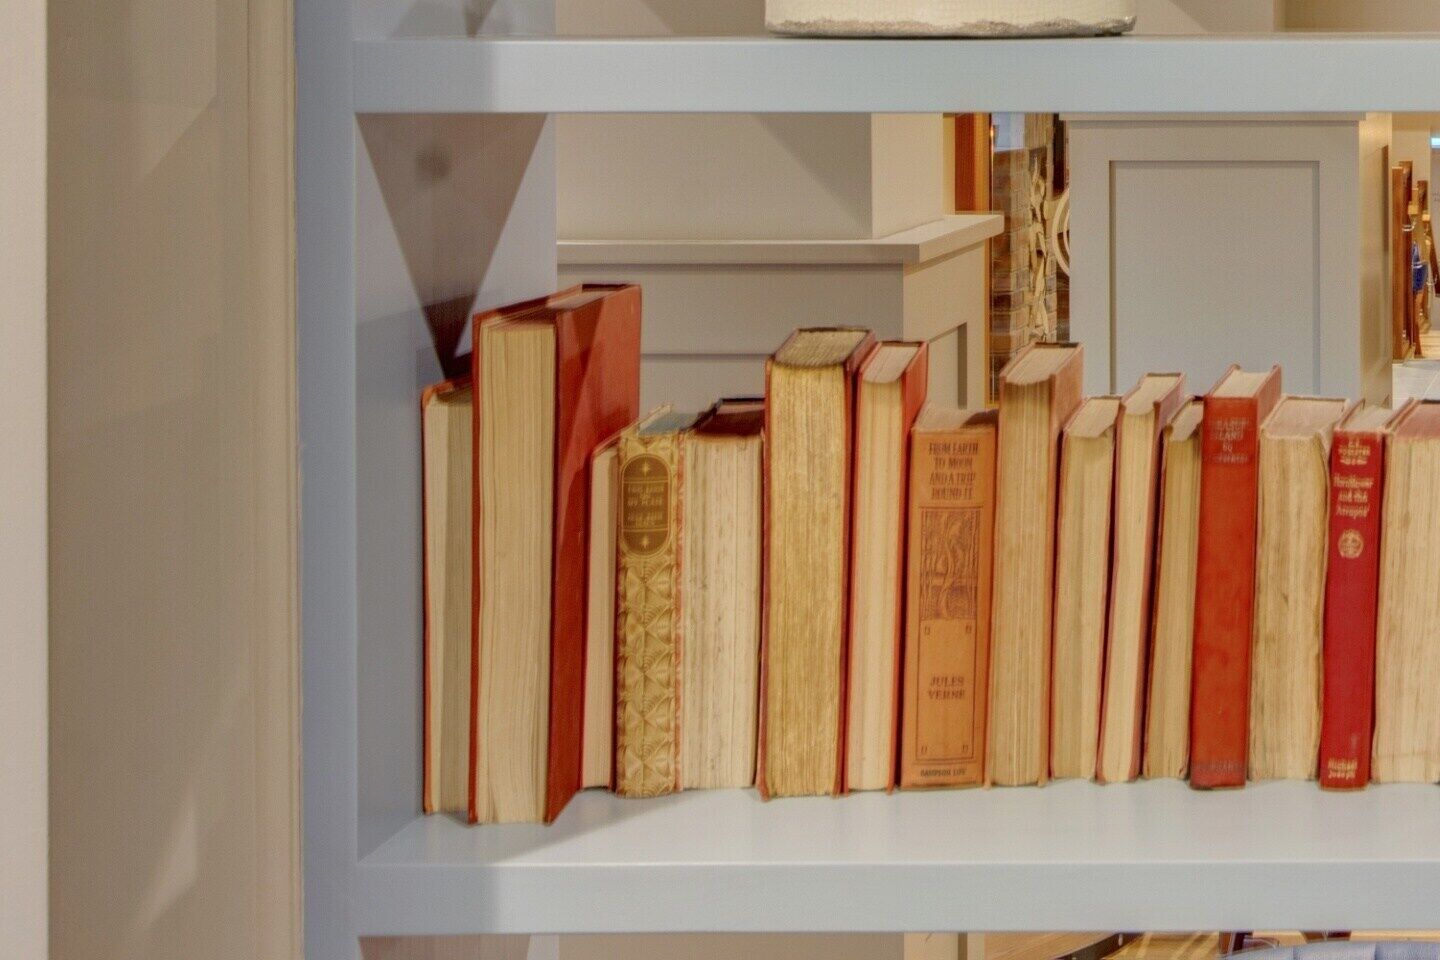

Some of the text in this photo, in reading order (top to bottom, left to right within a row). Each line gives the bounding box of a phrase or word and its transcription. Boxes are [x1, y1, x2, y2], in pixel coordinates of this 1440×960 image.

[952, 442, 979, 455] EARTH
[934, 457, 973, 470] TO MOON
[929, 472, 948, 485] AND
[931, 676, 964, 687] JULES
[928, 689, 965, 700] VERNE
[1328, 758, 1358, 769] Michael
